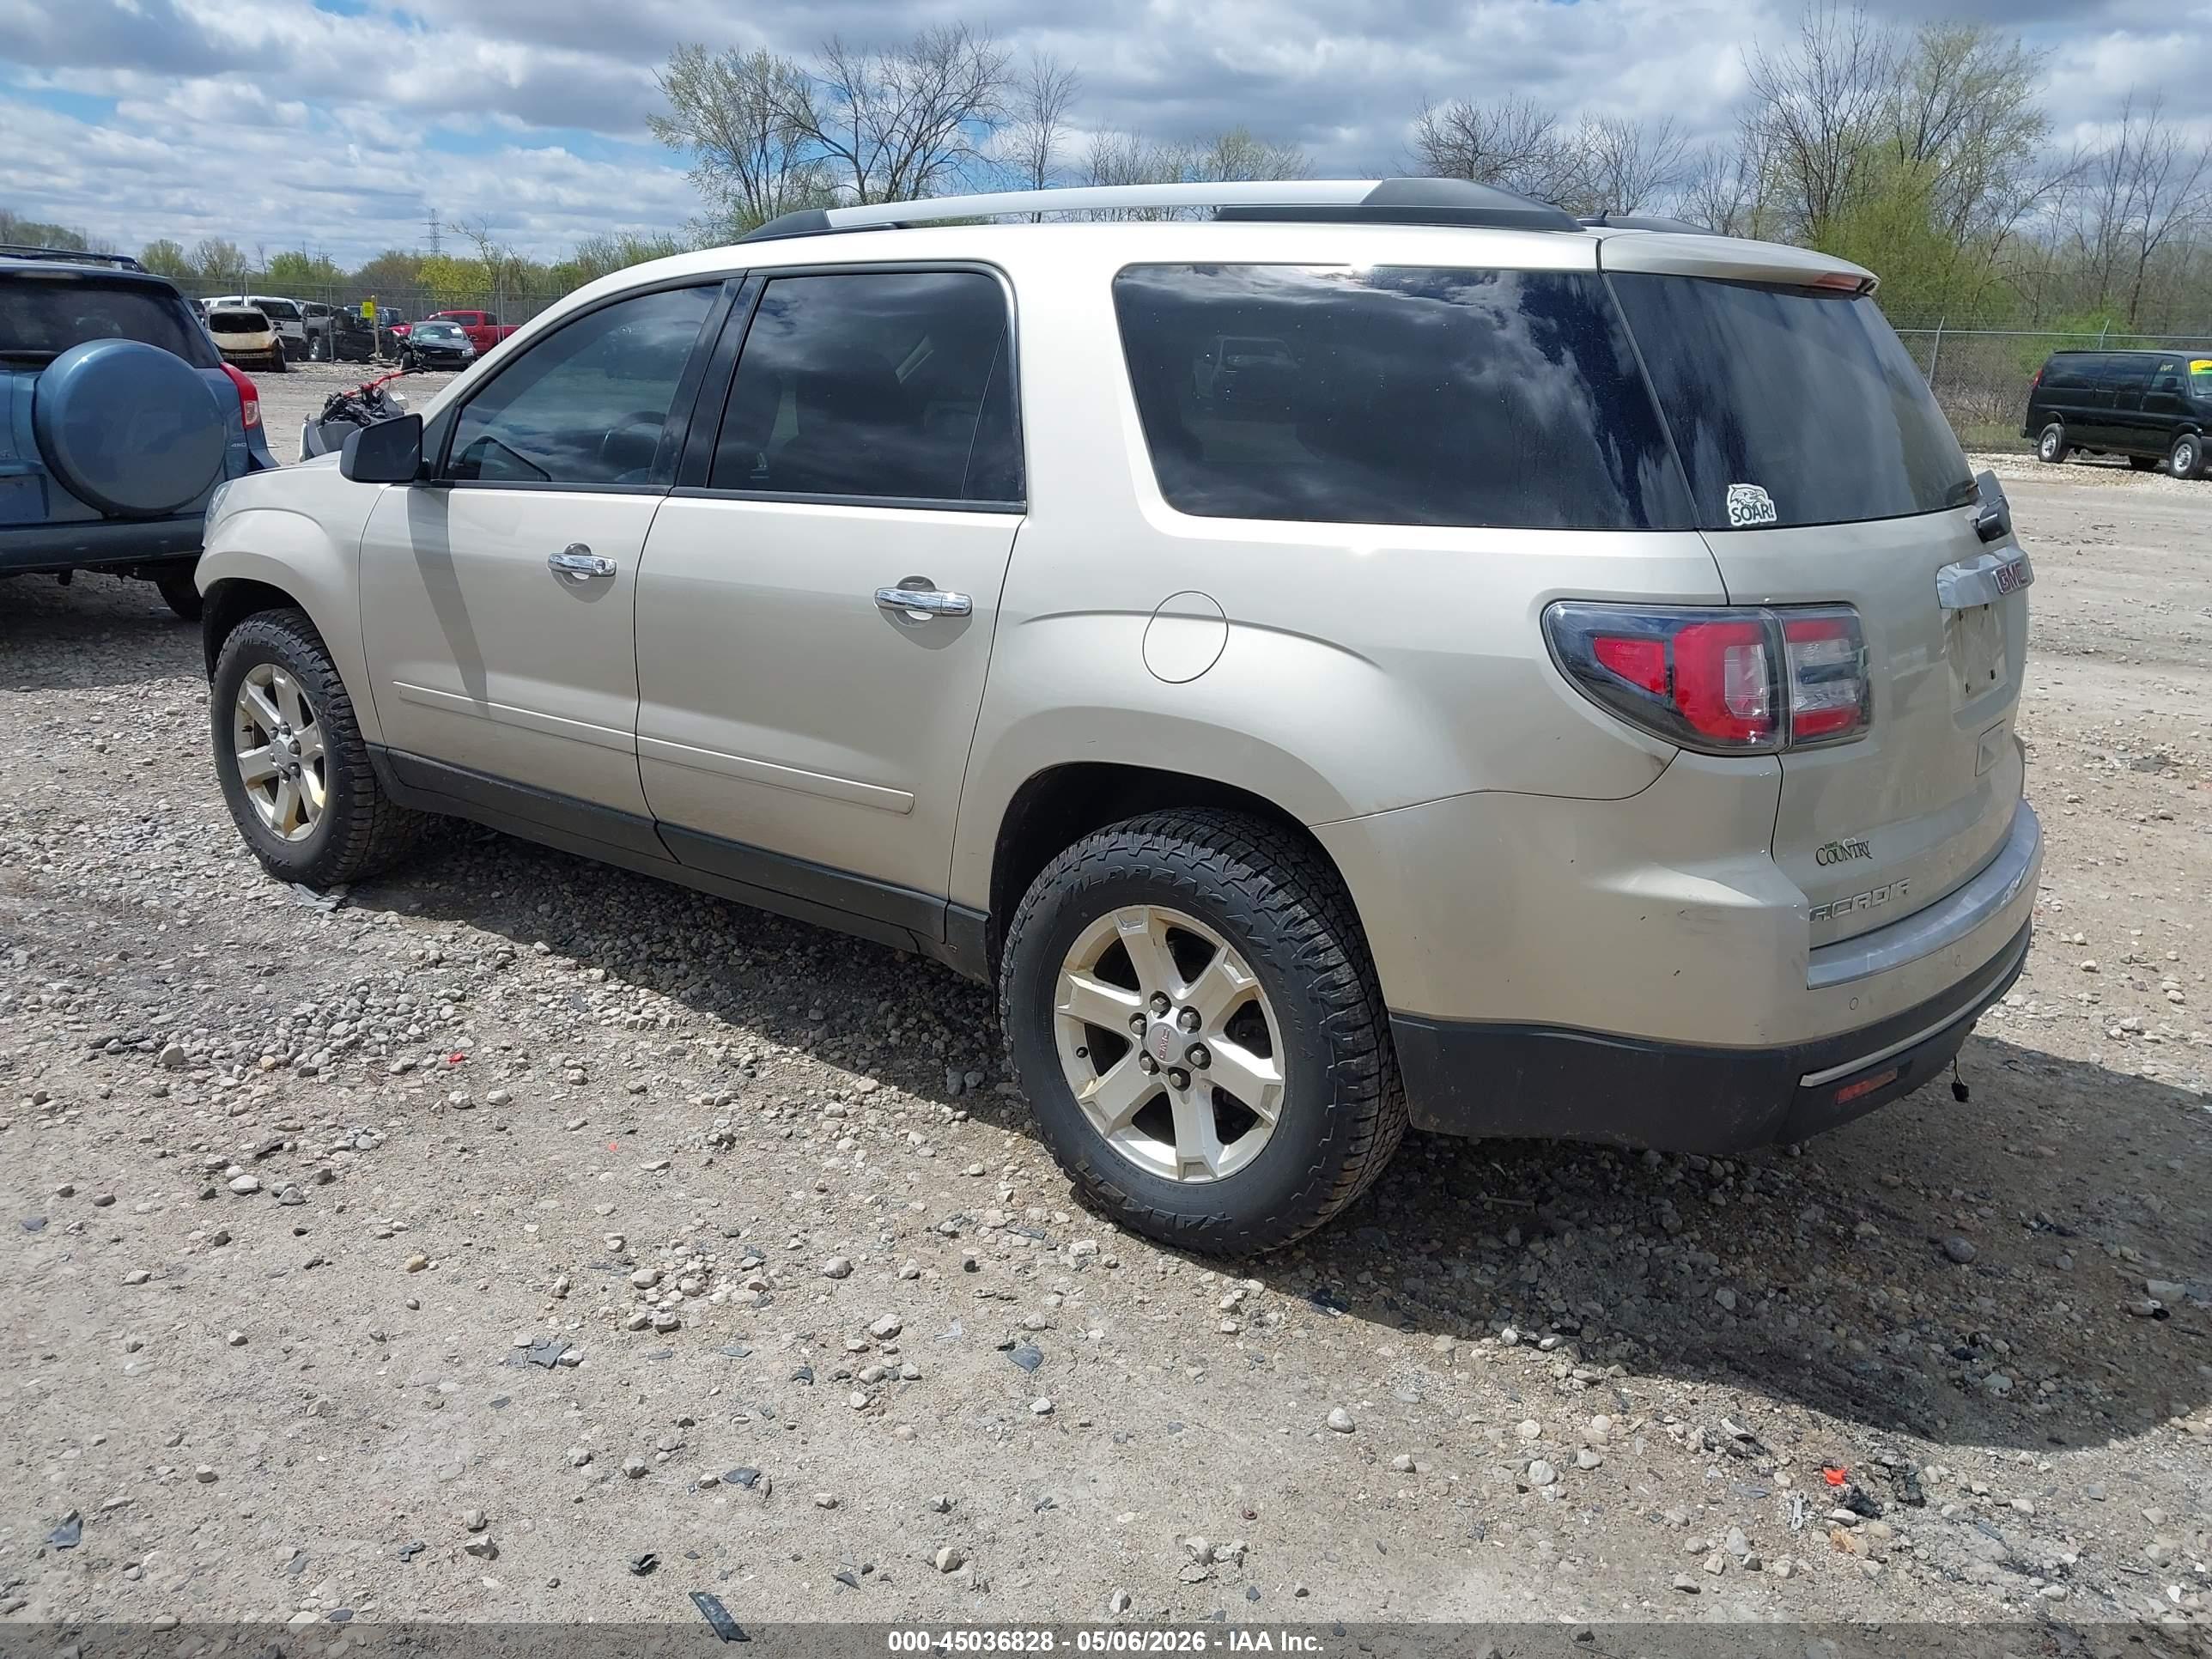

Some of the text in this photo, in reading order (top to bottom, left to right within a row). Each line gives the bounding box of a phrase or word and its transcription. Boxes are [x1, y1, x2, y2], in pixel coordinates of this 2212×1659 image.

[1731, 502, 1775, 523] SOAR!
[1992, 561, 2028, 593] GMC
[1815, 840, 1874, 866] COUNTRY
[1808, 877, 1911, 923] ACADIA
